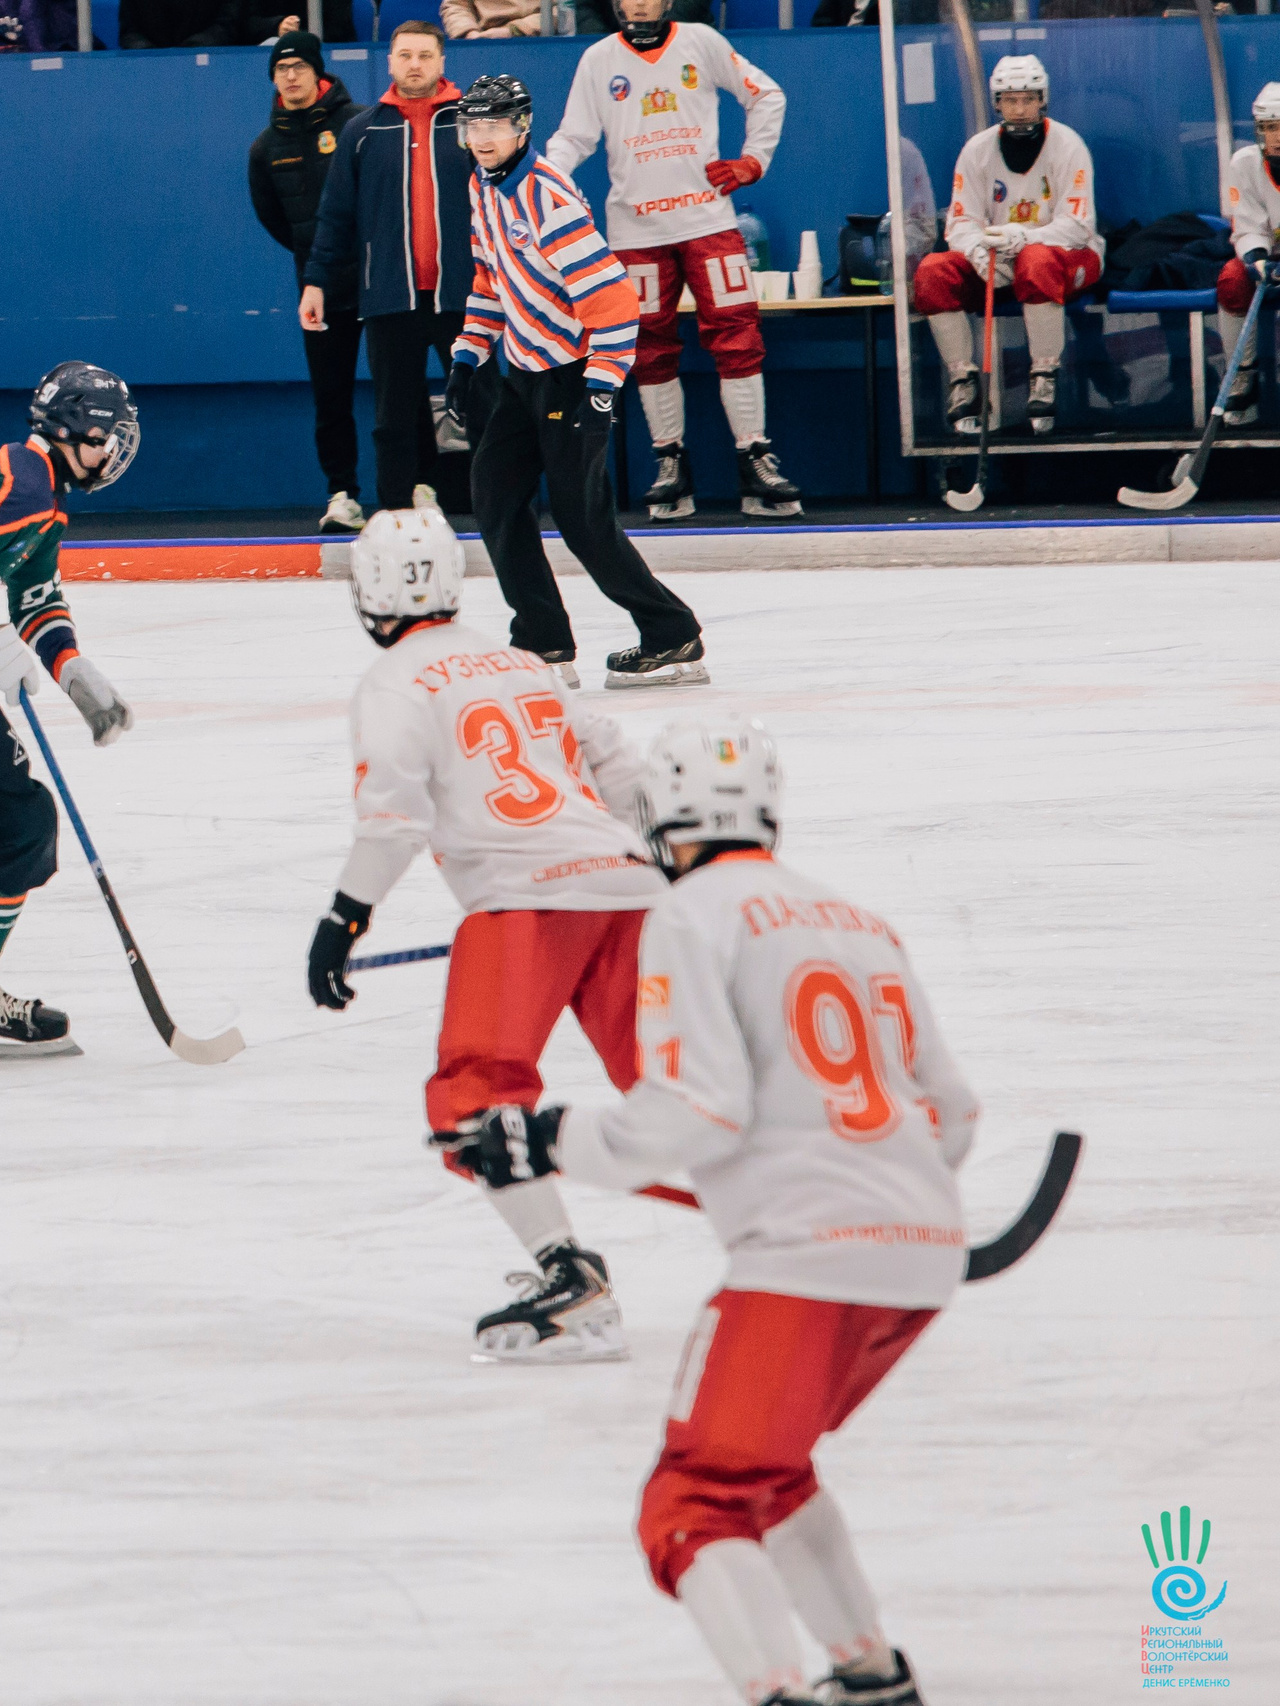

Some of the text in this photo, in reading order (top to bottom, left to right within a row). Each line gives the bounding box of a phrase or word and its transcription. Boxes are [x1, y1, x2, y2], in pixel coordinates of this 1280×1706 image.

[88, 408, 114, 418] CCM
[404, 560, 434, 584] 37
[455, 690, 608, 828] 37
[782, 957, 920, 1144] 91
